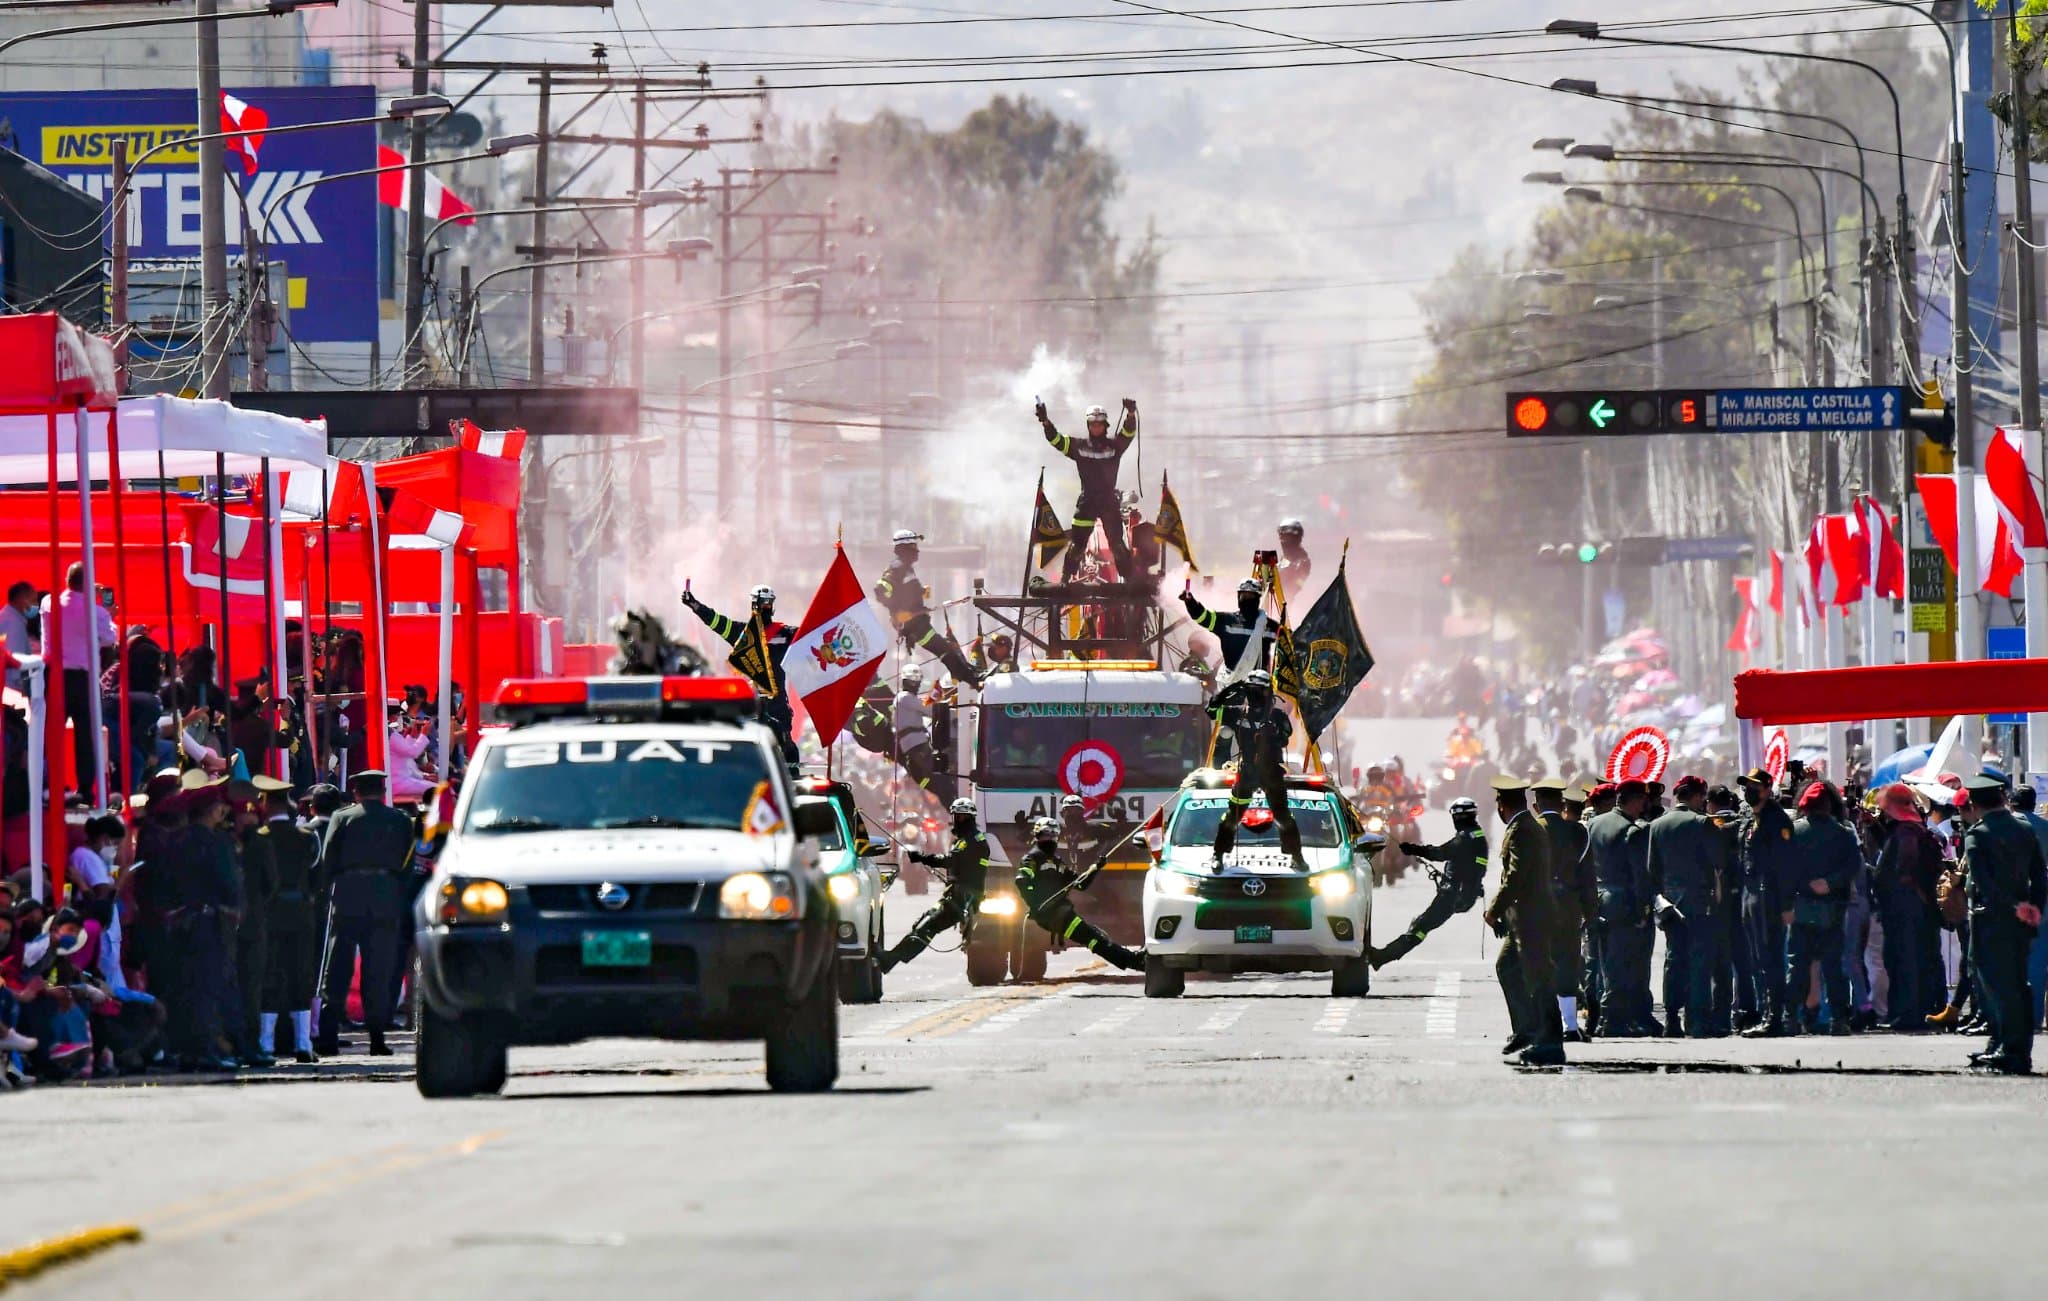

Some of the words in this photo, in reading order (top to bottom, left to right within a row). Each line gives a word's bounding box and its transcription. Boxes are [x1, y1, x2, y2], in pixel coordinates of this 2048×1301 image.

[1721, 396, 1738, 409] Av.
[1744, 395, 1807, 409] MARISCAL
[1812, 394, 1872, 408] CASTILLA
[1680, 399, 1696, 423] 5
[1721, 411, 1801, 426] MIRAFLORES
[1004, 702, 1182, 718] CARRETERAS
[504, 740, 732, 769] SUAT
